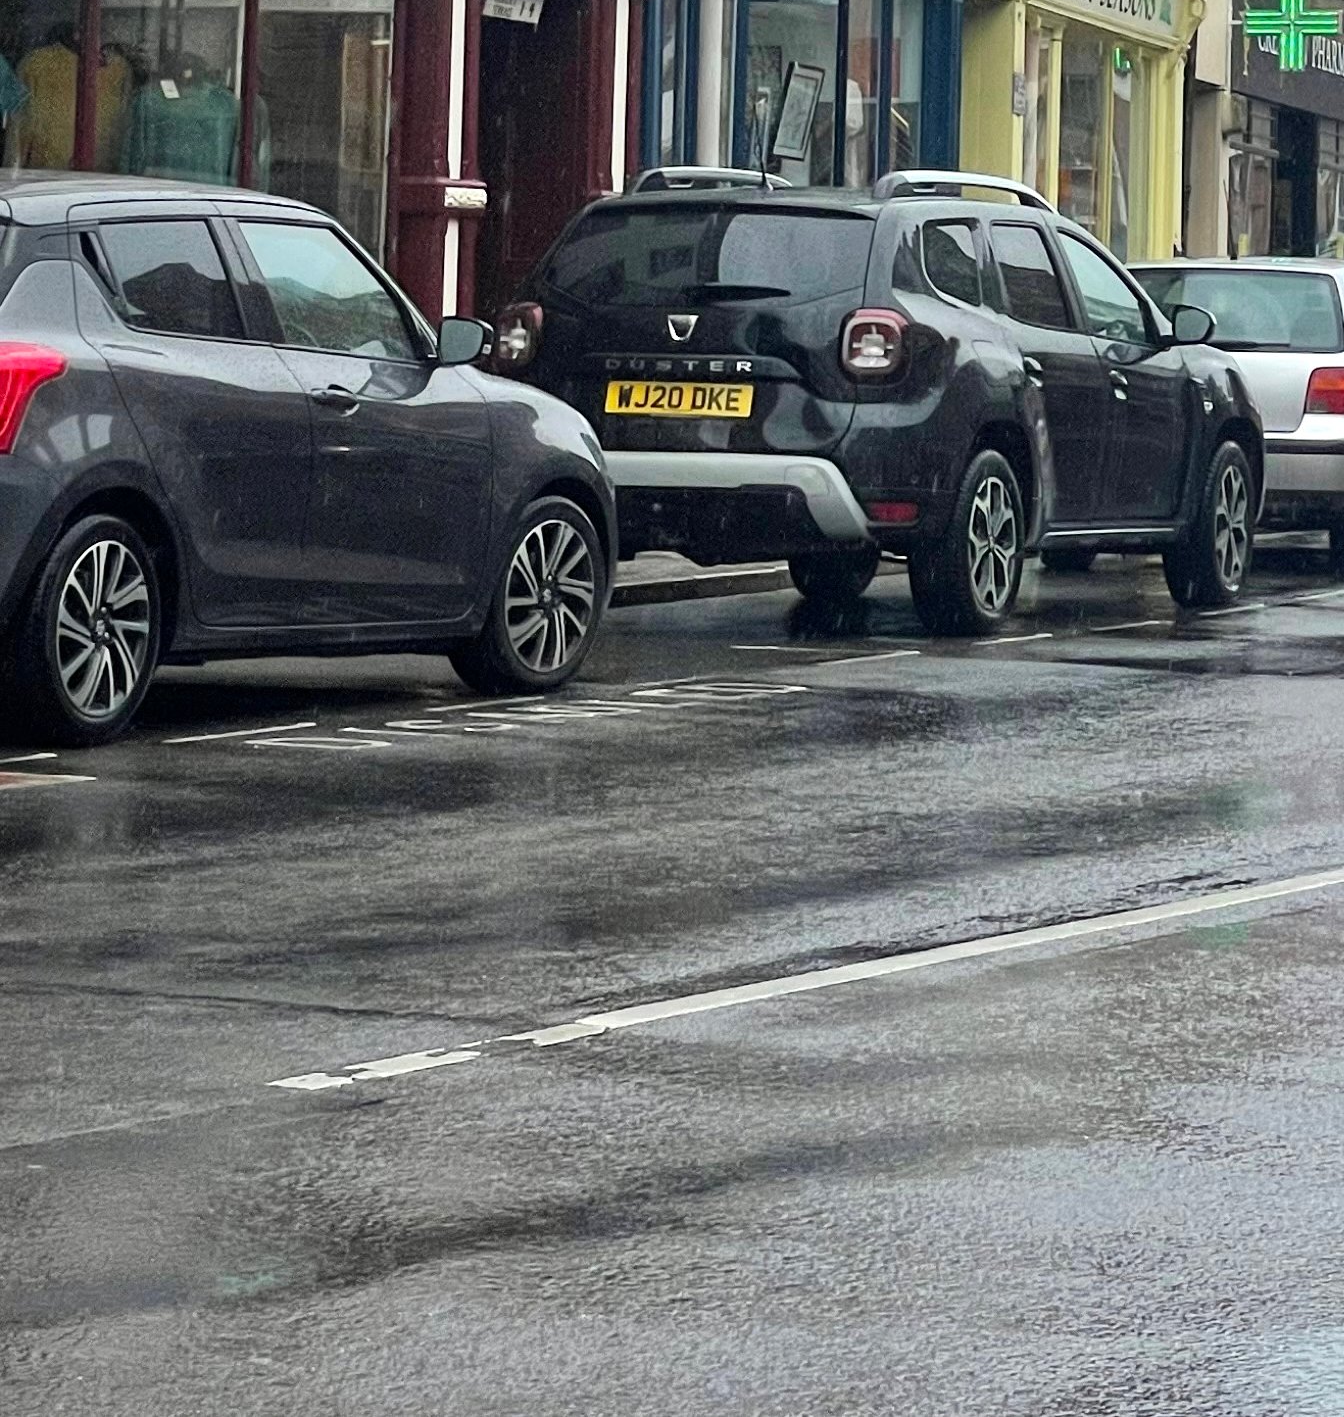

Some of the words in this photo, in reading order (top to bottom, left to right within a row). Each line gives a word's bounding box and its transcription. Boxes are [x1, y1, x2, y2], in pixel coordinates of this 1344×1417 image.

[605, 360, 753, 373] DUSTER
[618, 385, 683, 409] WJ20
[691, 386, 742, 411] DKE
